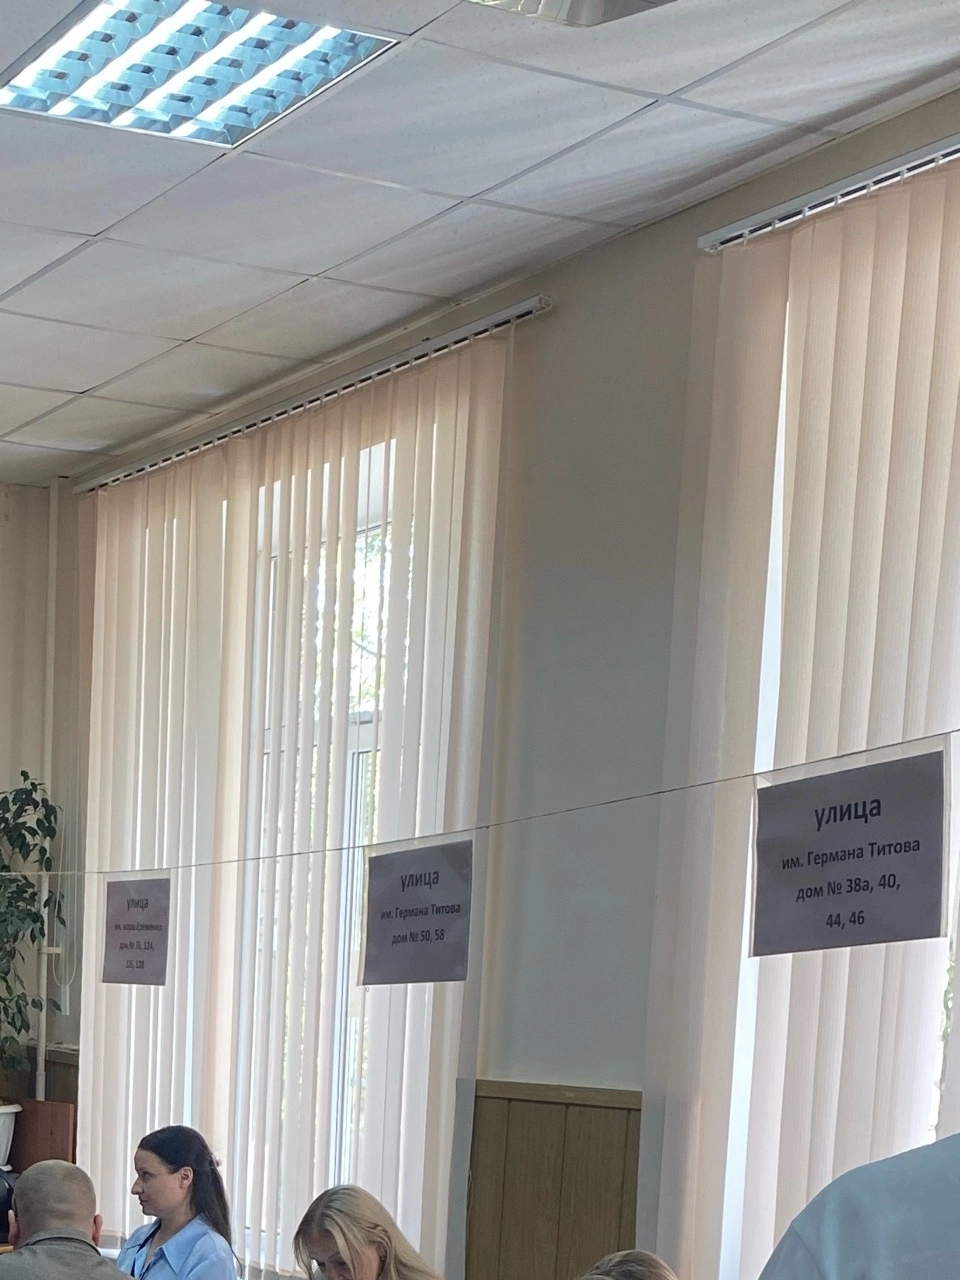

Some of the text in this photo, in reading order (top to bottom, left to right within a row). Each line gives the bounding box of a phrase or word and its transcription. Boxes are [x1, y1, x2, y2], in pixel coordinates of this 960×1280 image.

[814, 798, 882, 831] улица
[782, 839, 920, 871] им. Германа Титова
[400, 870, 440, 892] улица
[796, 873, 901, 902] дом № 38а, 40,
[395, 907, 429, 920] Германа
[431, 903, 461, 916] Титова
[826, 910, 865, 930] 44, 46
[392, 934, 408, 946] дом
[420, 931, 433, 943] 50,
[434, 929, 445, 942] 58
